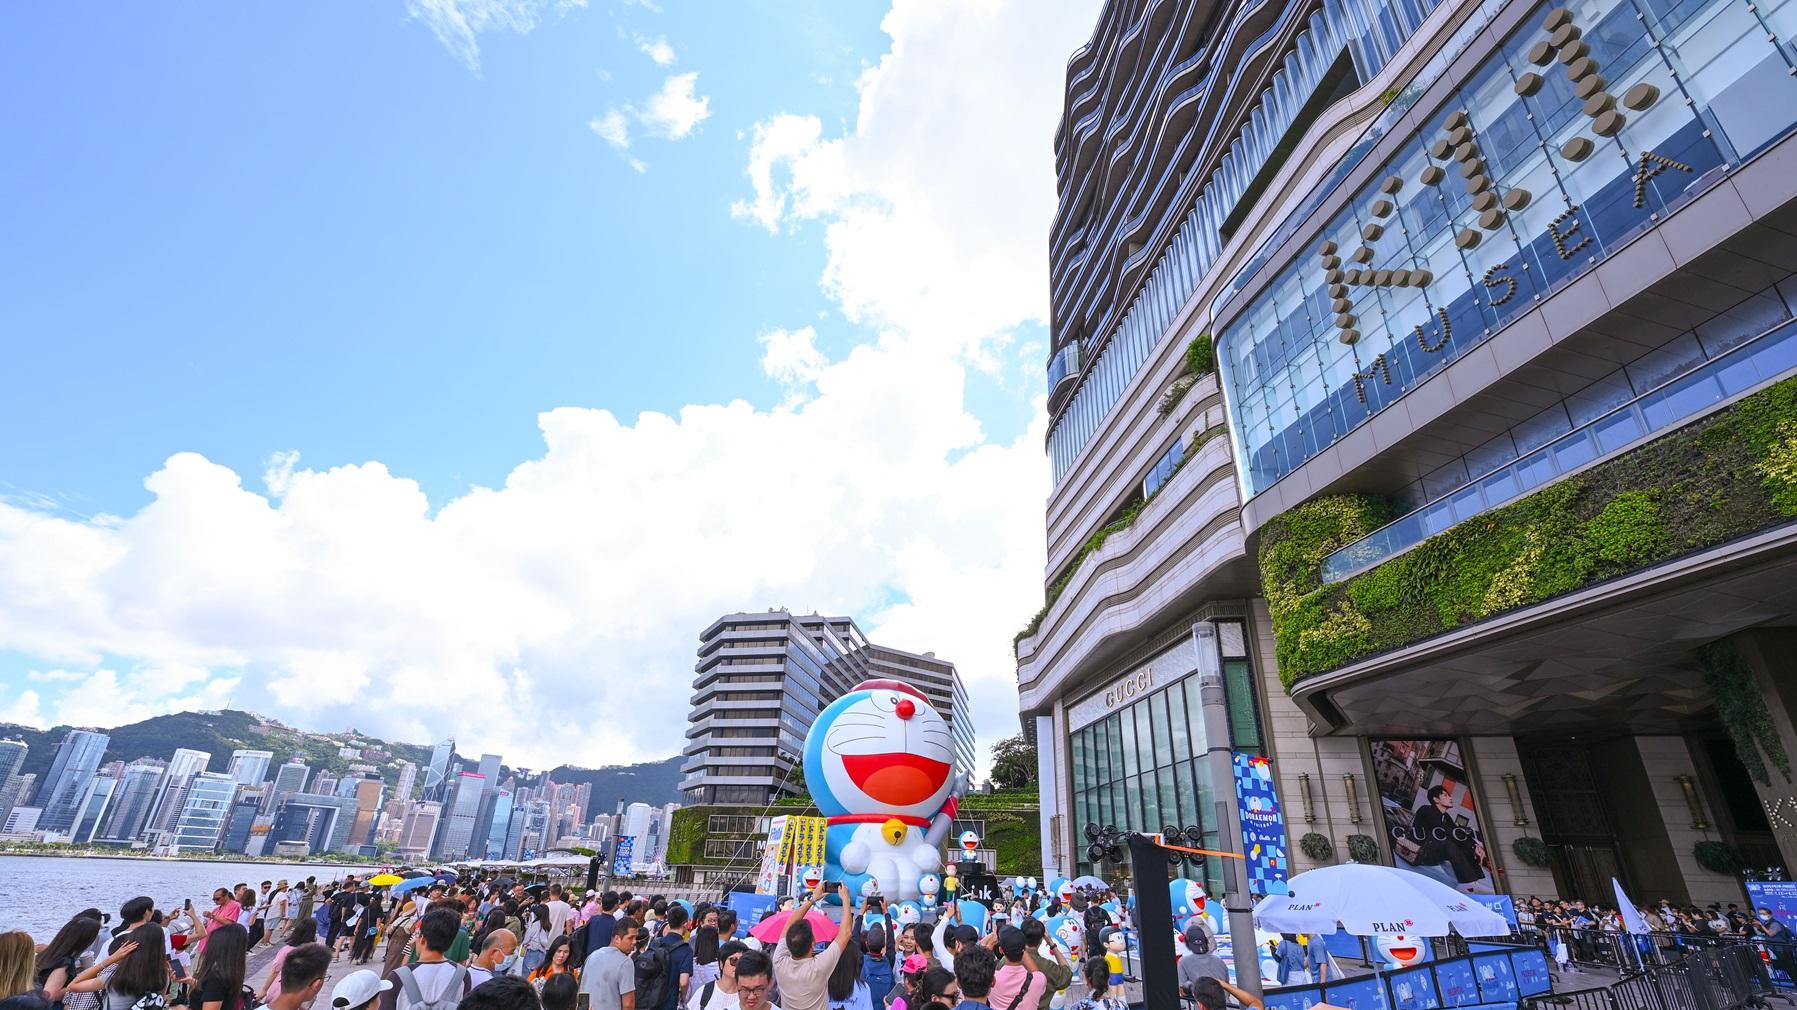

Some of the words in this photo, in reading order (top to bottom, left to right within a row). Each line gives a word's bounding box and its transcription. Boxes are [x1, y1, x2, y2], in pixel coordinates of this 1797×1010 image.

[1318, 7, 1660, 346] K11
[1352, 150, 1694, 404] MUSEA
[1105, 667, 1153, 708] GUCCI
[1245, 811, 1278, 823] DORAEMON
[1391, 826, 1478, 842] GUCCI
[1288, 903, 1313, 911] PLAN
[1372, 922, 1406, 932] PLAN
